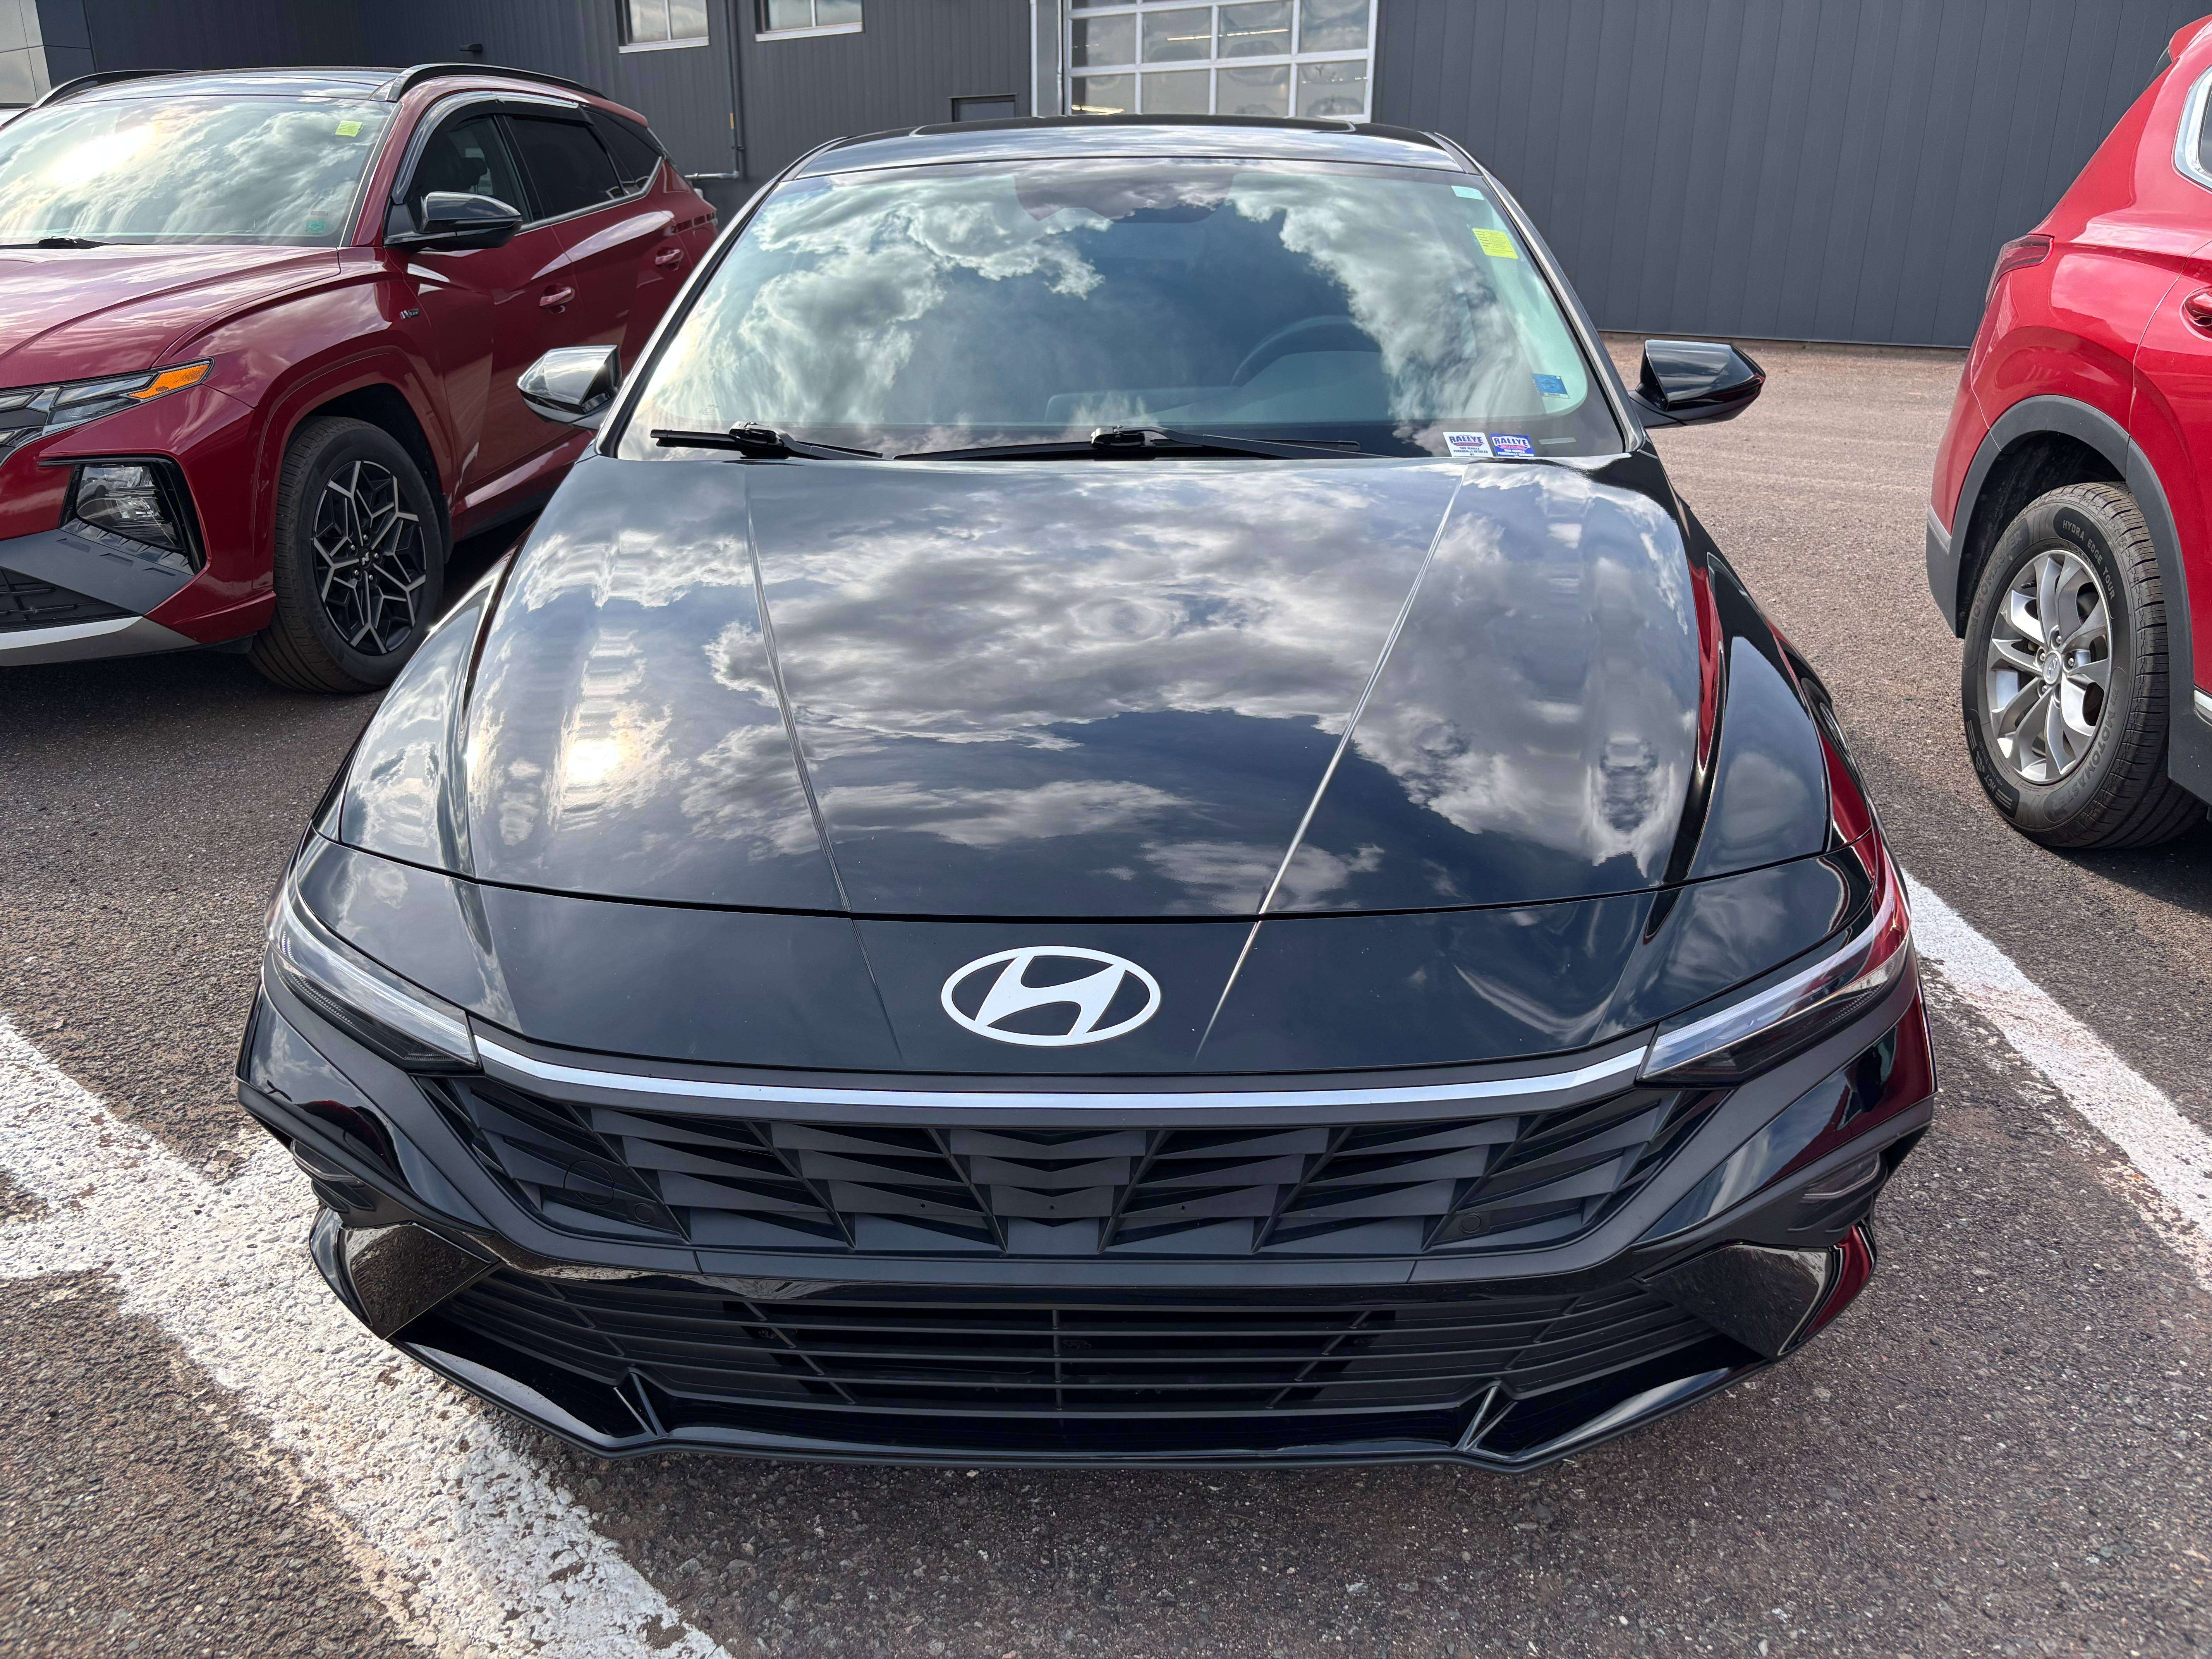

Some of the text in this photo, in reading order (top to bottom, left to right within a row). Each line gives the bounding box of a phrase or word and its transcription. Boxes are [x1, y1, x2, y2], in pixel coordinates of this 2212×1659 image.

[1494, 438, 1528, 446] RALLYE
[2063, 520, 2084, 541] HYDRA
[2087, 539, 2103, 565] EDGE
[2103, 567, 2115, 600] TOUR
[1984, 775, 1997, 792] HCT
